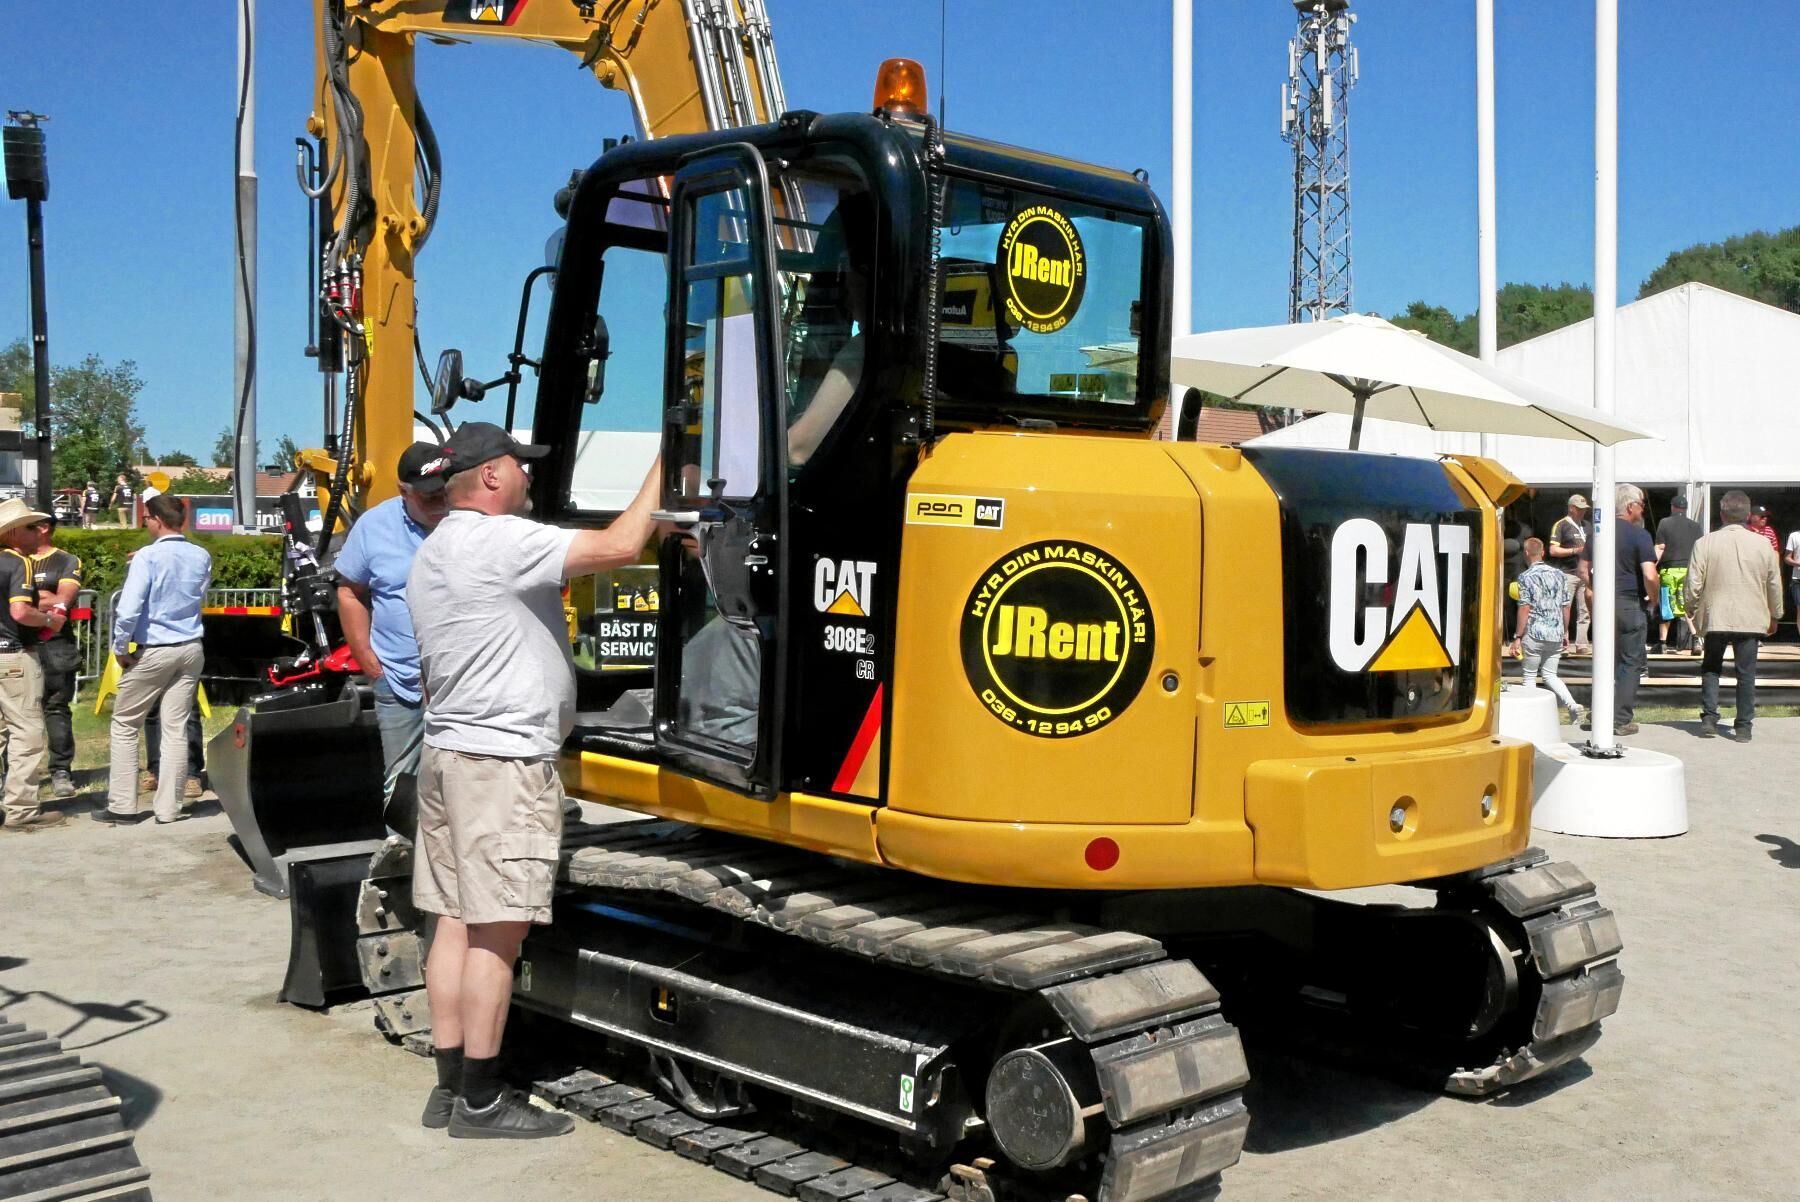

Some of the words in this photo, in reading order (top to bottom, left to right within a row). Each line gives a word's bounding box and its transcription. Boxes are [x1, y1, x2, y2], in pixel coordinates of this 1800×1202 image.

[1002, 222, 1019, 249] HYR
[1017, 206, 1036, 223] DIN
[1036, 205, 1075, 240] MASKIN
[1011, 242, 1071, 287] JRent
[199, 512, 230, 525] am
[917, 502, 963, 516] pon
[976, 504, 1000, 520] CAT
[814, 557, 877, 617] CAT
[971, 573, 1004, 617] HYR
[1002, 549, 1040, 576] DIN
[1044, 546, 1128, 590] MASKIN
[1123, 589, 1146, 643] HÄR!
[1329, 518, 1470, 672] CAT
[600, 619, 640, 637] BÄST
[992, 604, 1121, 662] JRent
[600, 641, 654, 656] SERVIC
[856, 659, 875, 680] CR
[982, 688, 1017, 722] 036
